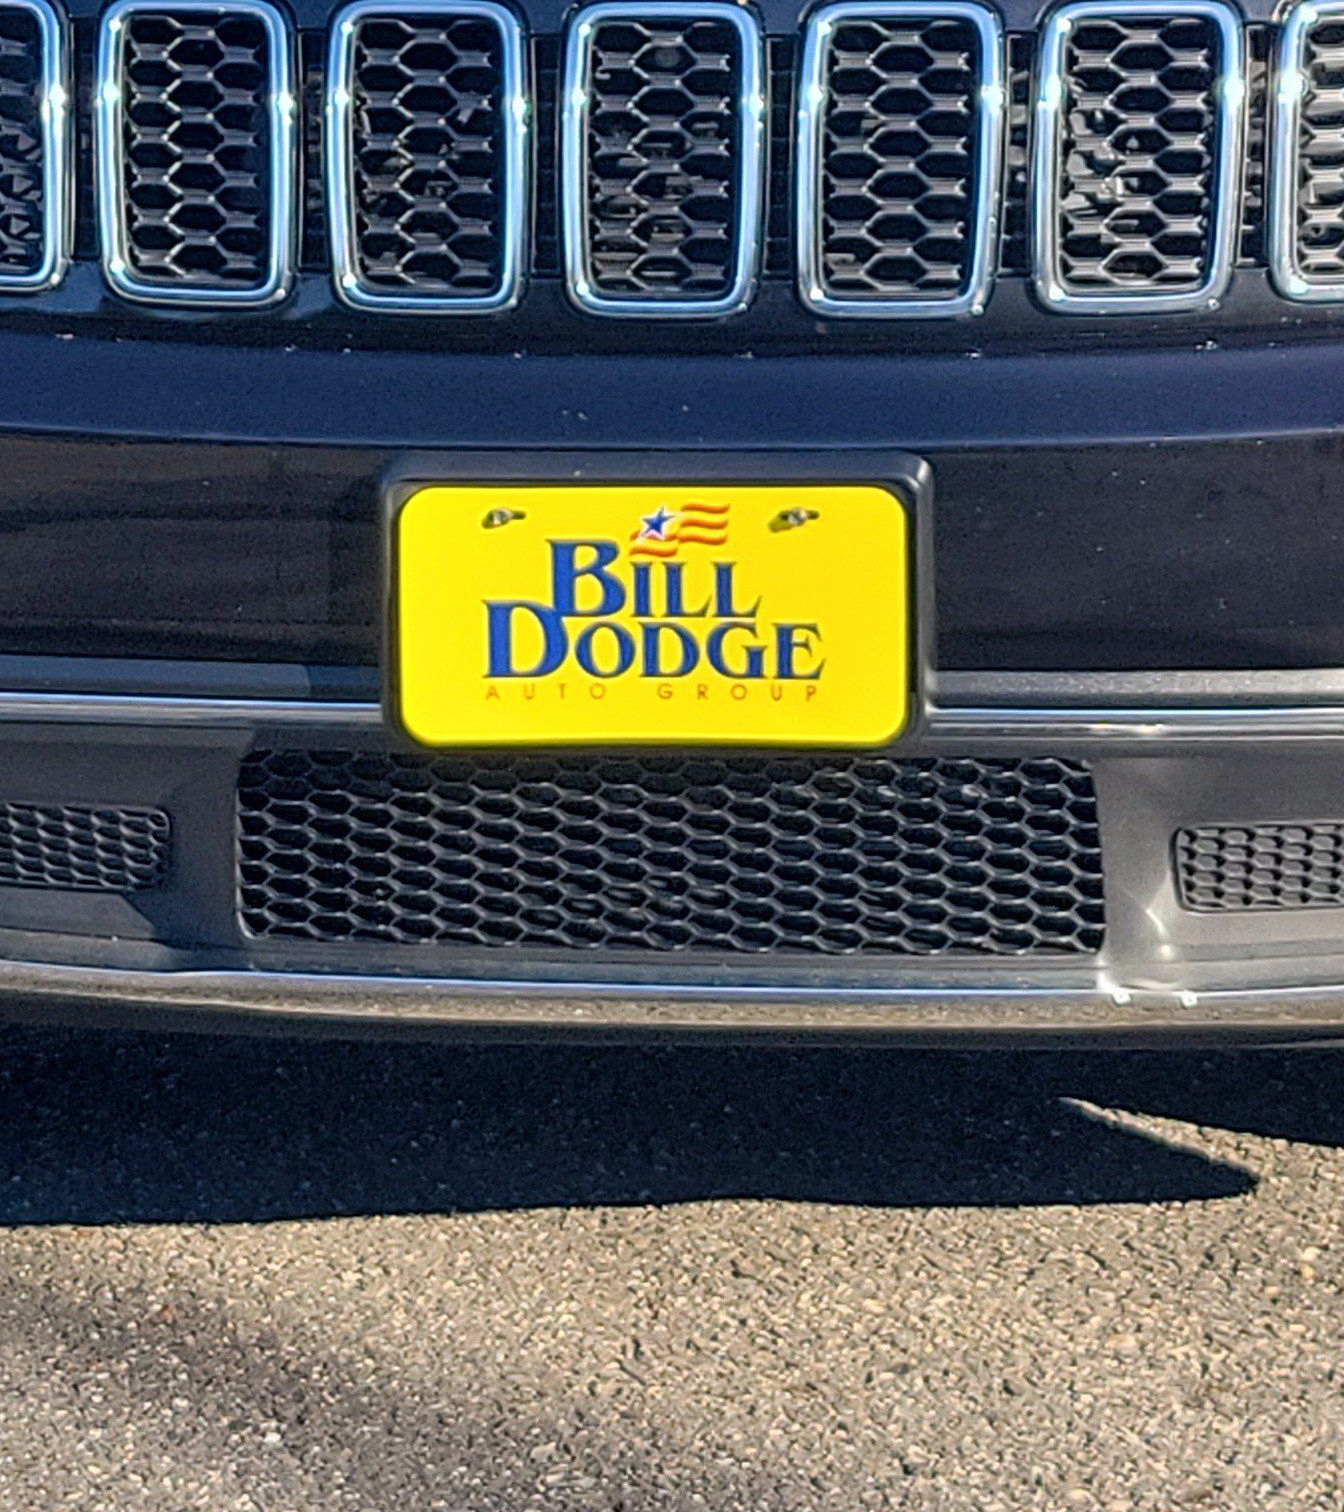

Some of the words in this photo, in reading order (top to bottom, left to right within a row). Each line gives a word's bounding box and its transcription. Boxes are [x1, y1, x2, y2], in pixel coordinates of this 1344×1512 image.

[546, 539, 762, 618] BILL
[482, 599, 826, 680] DODGE
[485, 684, 606, 701] AUTO
[657, 684, 817, 702] GROUP
